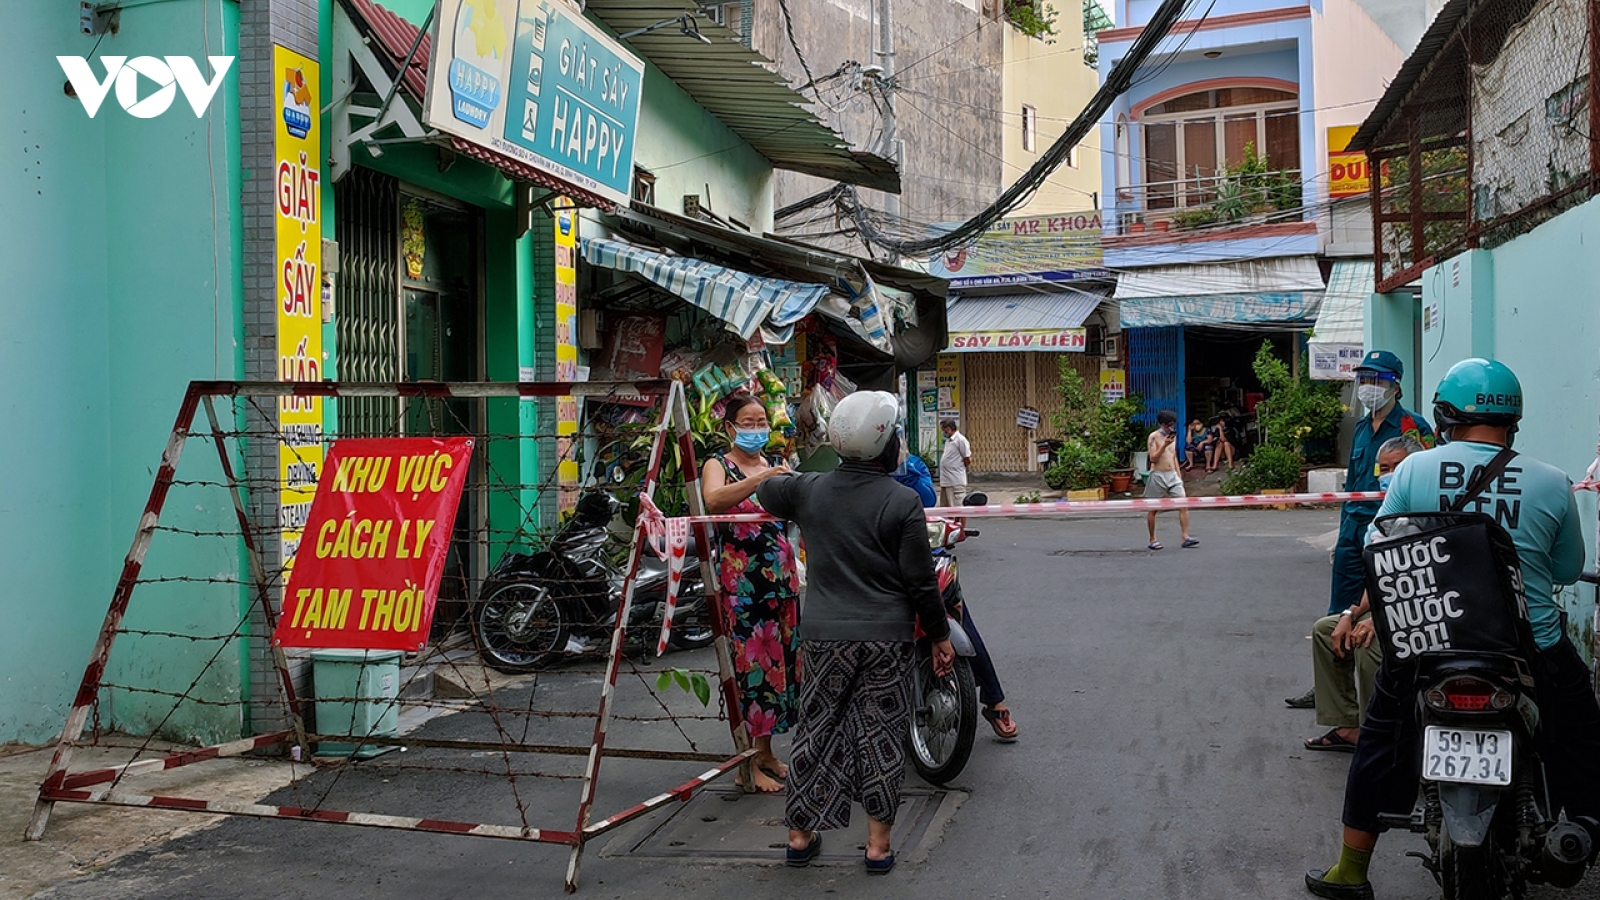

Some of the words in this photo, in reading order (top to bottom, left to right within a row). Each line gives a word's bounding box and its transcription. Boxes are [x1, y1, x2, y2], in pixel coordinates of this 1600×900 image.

[455, 62, 497, 103] HAPPY
[559, 38, 597, 91] GIẶT
[601, 62, 629, 111] SẤY
[550, 94, 624, 178] HAPPY
[278, 152, 318, 232] GIẶT
[1013, 219, 1041, 236] MR
[1047, 214, 1102, 233] KHOA
[283, 242, 315, 315] SẤY
[953, 332, 992, 348] SẤY
[997, 329, 1034, 347] LẤY
[282, 336, 318, 411] HẤP
[283, 424, 320, 446] WASHING
[287, 463, 316, 486] DRYING
[331, 455, 391, 493] KHU
[396, 450, 453, 501] VỰC
[1440, 461, 1522, 495] BAE
[315, 510, 392, 559] CÁCH
[396, 519, 435, 559] LY
[1373, 536, 1451, 577] NƯỚC
[1377, 569, 1438, 604] SÔI!
[291, 588, 353, 638] TẠM
[358, 580, 425, 632] THỜI
[1384, 591, 1465, 632] NƯỚC
[1391, 622, 1451, 659] SÔI!
[1438, 731, 1499, 755] 59-V3
[1429, 754, 1507, 782] 267.34
